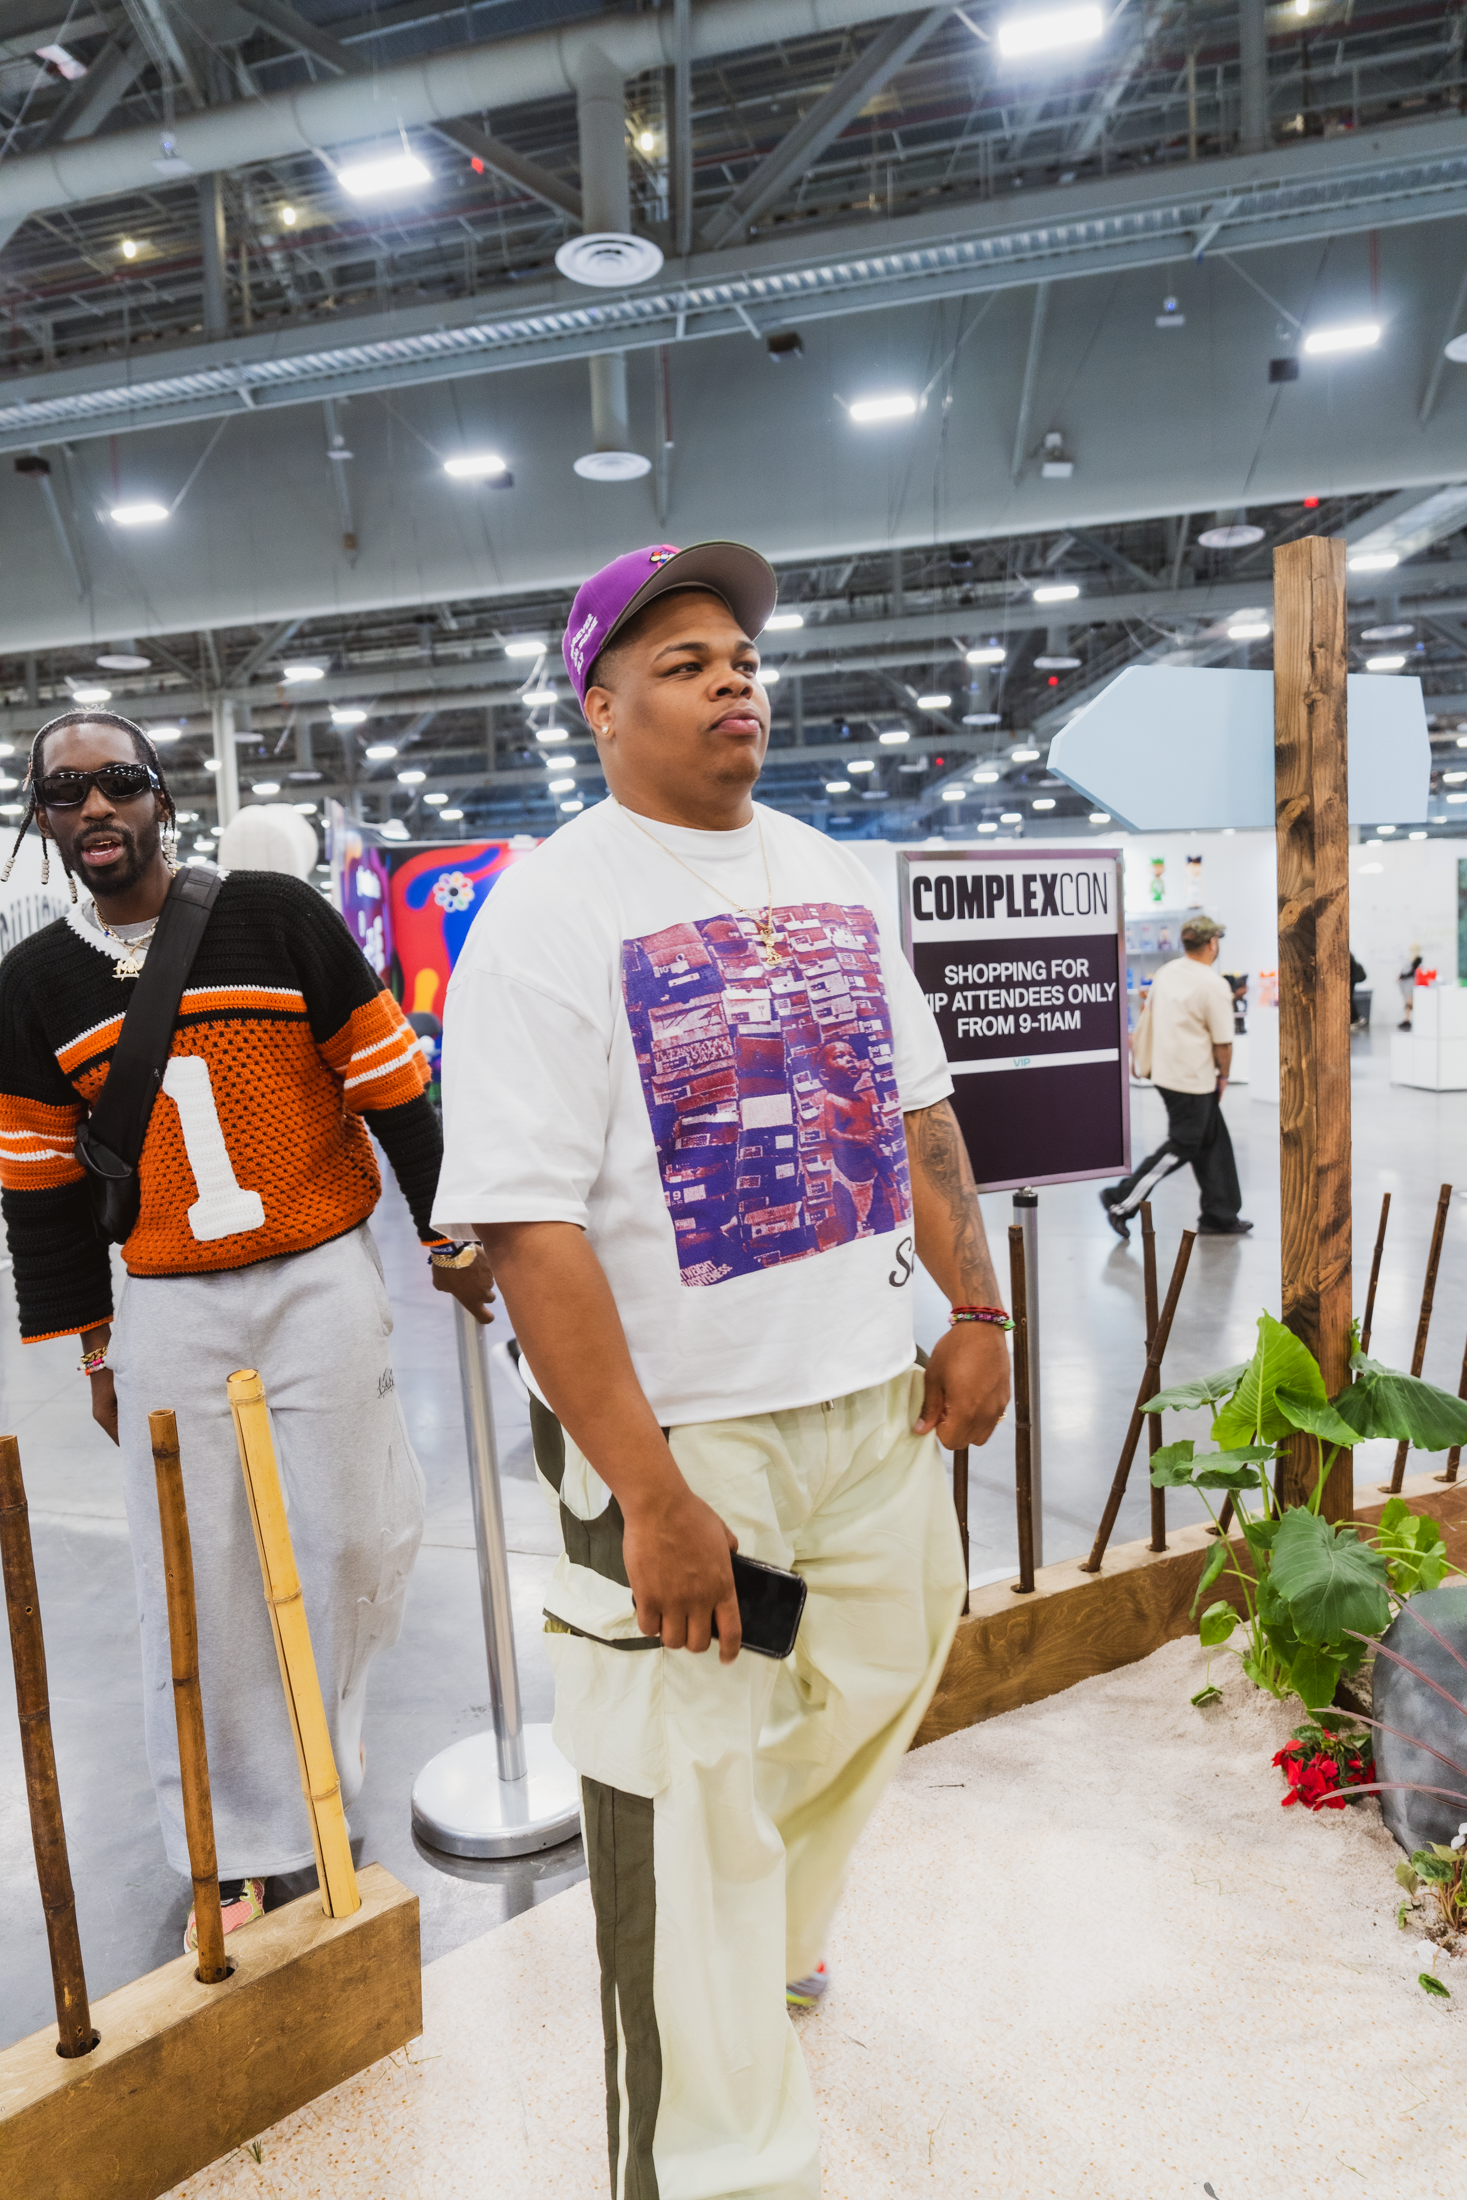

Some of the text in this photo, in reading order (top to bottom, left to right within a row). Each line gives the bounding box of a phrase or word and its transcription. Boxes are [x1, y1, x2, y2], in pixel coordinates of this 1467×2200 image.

[912, 872, 1108, 921] COMPLEXCON
[944, 958, 1089, 985] SHOPPING FOR
[951, 985, 1065, 1012] ATTENDEES
[1068, 982, 1116, 1004] ONLY
[957, 1010, 1081, 1038] FROM 9-11AM
[1013, 1058, 1031, 1067] VIP
[161, 1055, 265, 1242] 1
